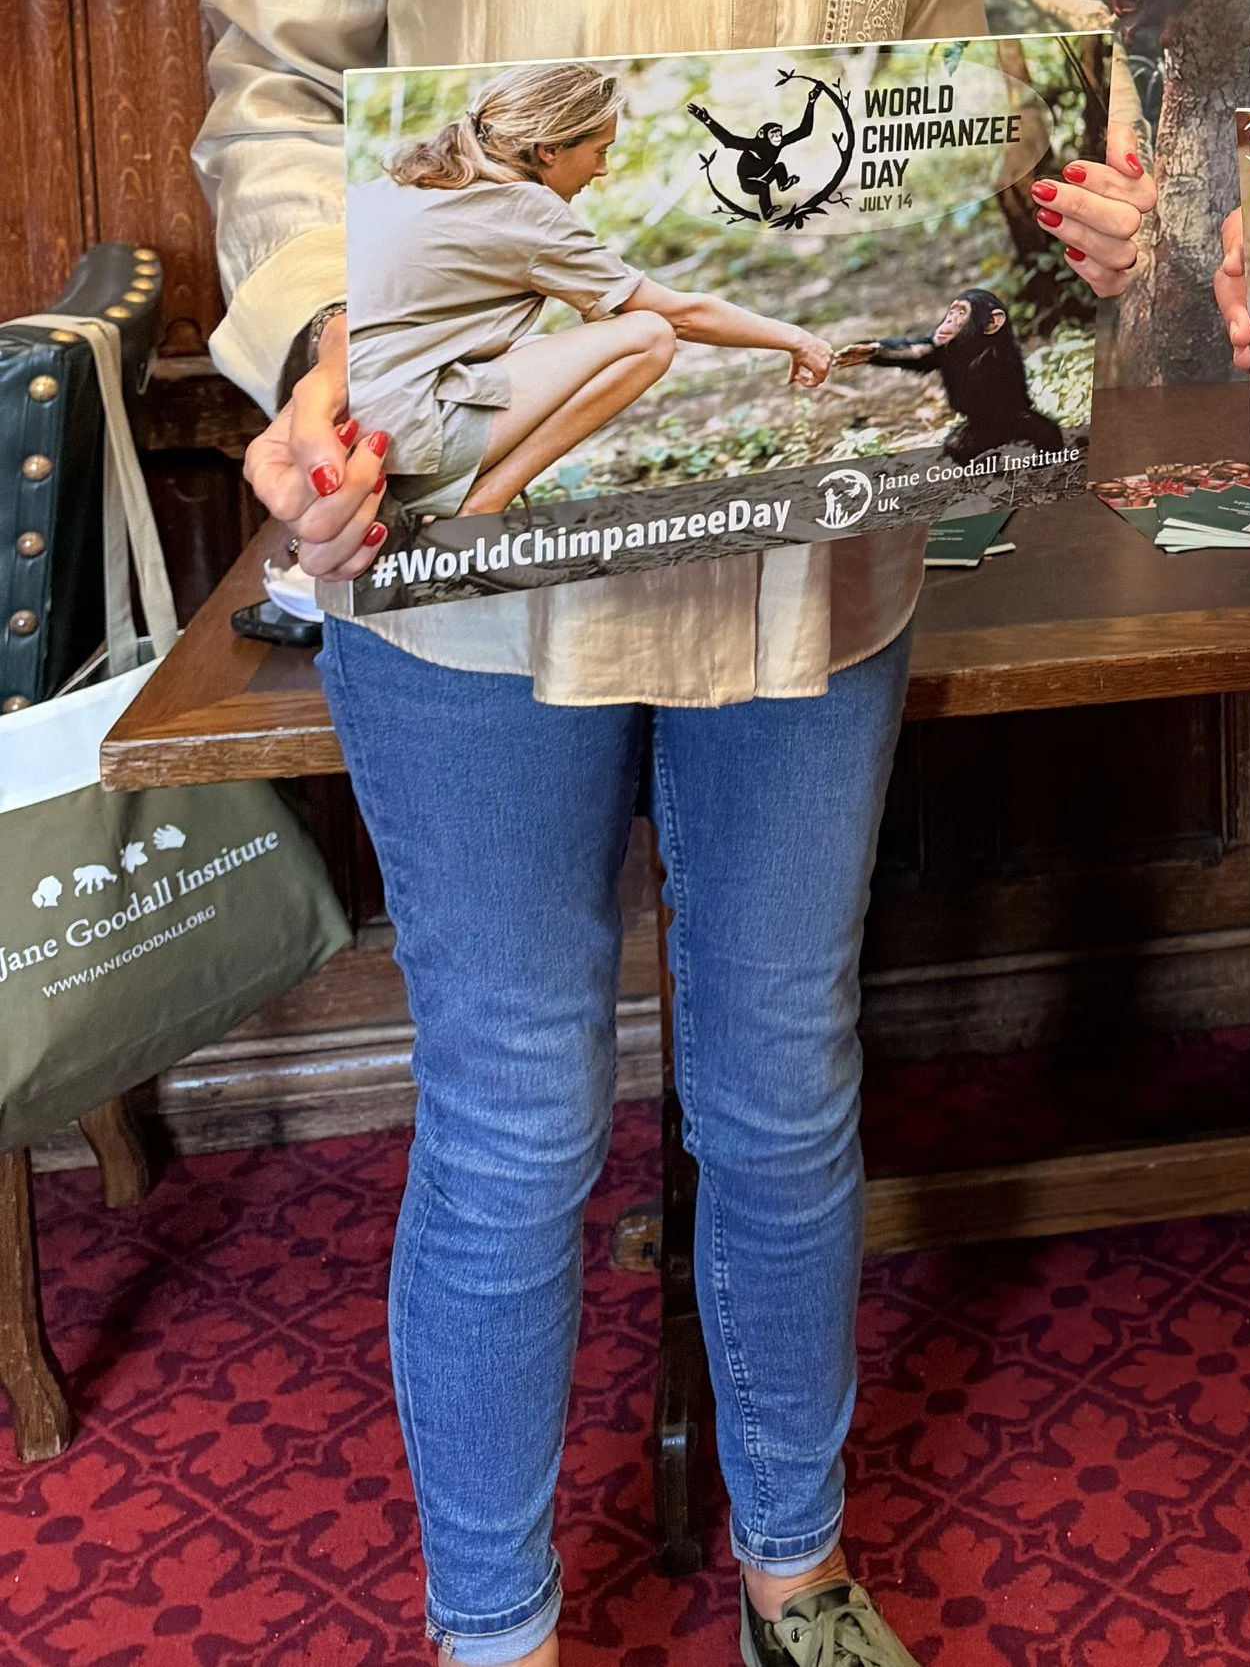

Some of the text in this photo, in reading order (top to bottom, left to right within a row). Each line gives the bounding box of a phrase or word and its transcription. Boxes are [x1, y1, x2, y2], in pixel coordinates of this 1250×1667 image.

[863, 84, 954, 119] WORLD
[862, 114, 1022, 155] CHIMPANZEE
[860, 157, 909, 191] DAY
[859, 194, 913, 214] JULY 14
[877, 448, 1080, 495] Jane Goodall Institute
[877, 496, 900, 512] UK
[372, 499, 791, 589] #WorldChimpanzeeDay
[0, 831, 280, 983] Jane Goodall Institute
[41, 905, 216, 998] WWW.JANEGOODALL.ORG
